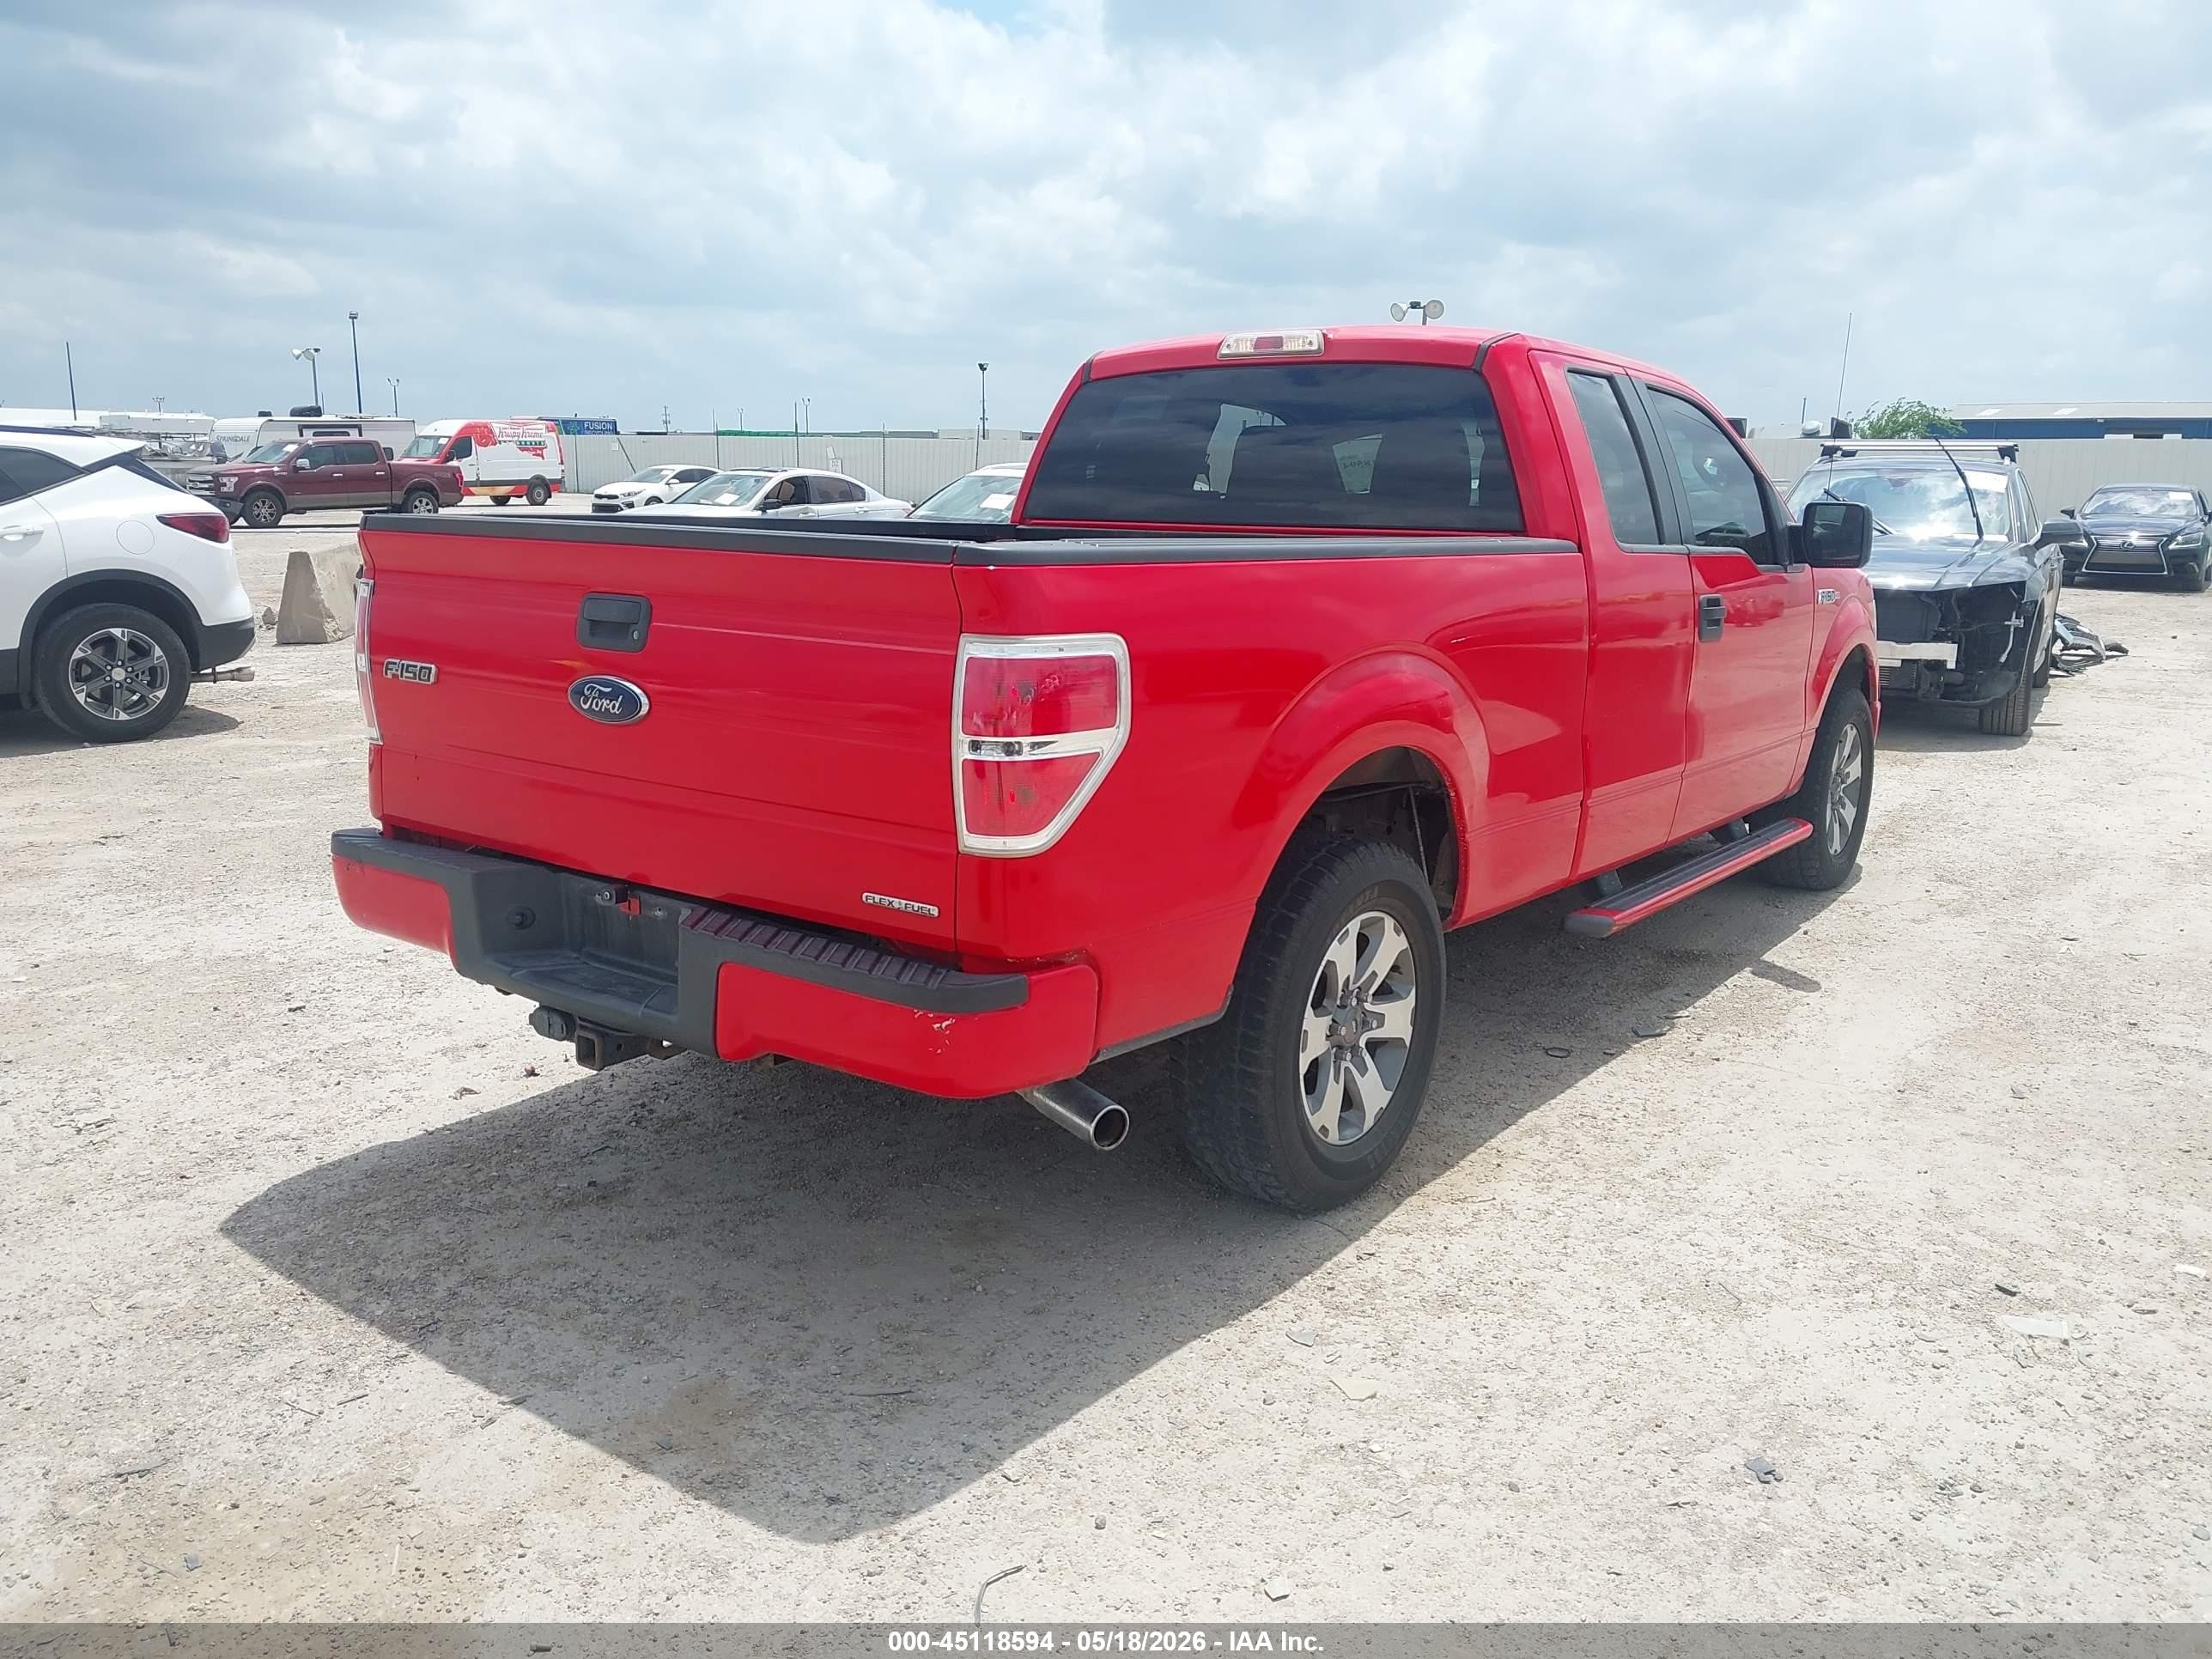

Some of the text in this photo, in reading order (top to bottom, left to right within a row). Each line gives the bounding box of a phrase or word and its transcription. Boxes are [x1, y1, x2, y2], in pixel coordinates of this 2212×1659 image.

[584, 422, 613, 430] FUSION
[384, 660, 434, 684] F-150
[580, 684, 623, 714] Ford
[865, 895, 935, 916] FLEX FUEL
